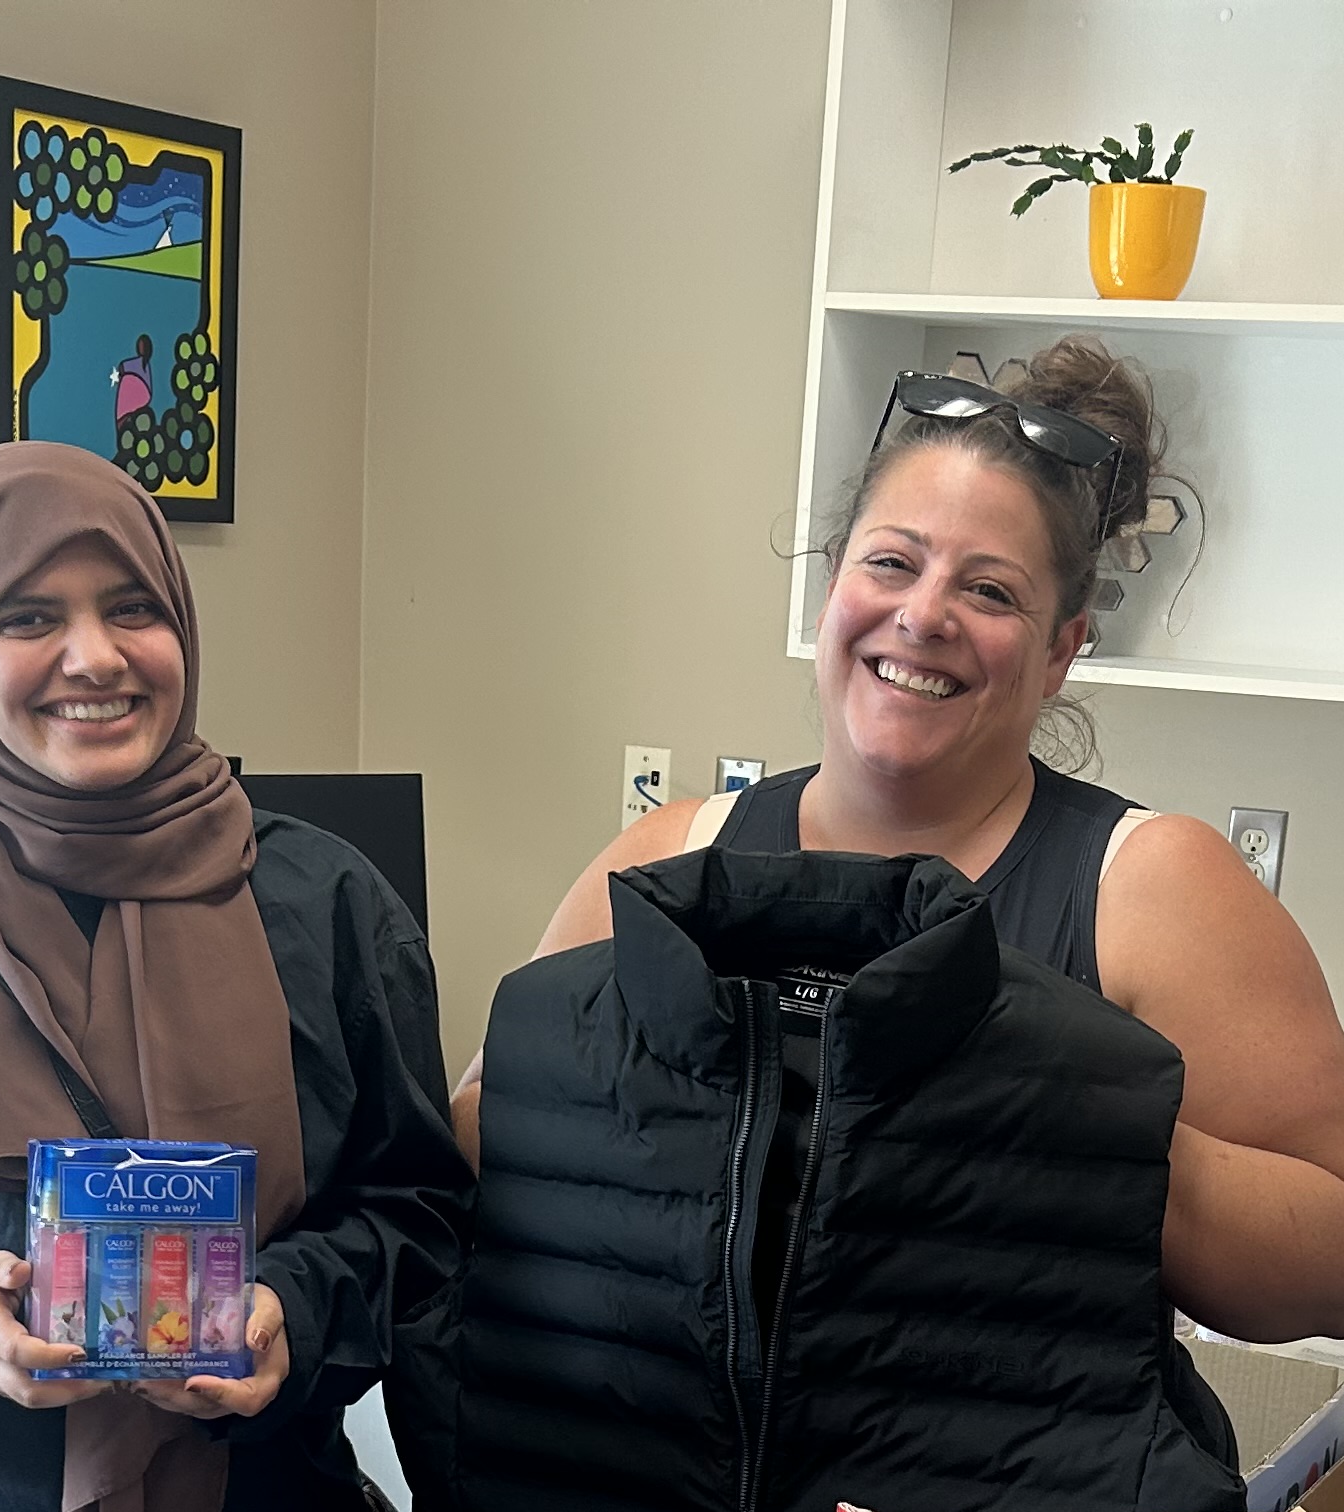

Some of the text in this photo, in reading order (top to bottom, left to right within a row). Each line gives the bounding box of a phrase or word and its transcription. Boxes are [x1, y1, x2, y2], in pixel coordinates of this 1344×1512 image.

[795, 985, 819, 999] L/G
[85, 1172, 214, 1200] CALGON
[106, 1202, 201, 1216] take me away!
[99, 1352, 197, 1360] FRAGRANCE SAMPLER SET
